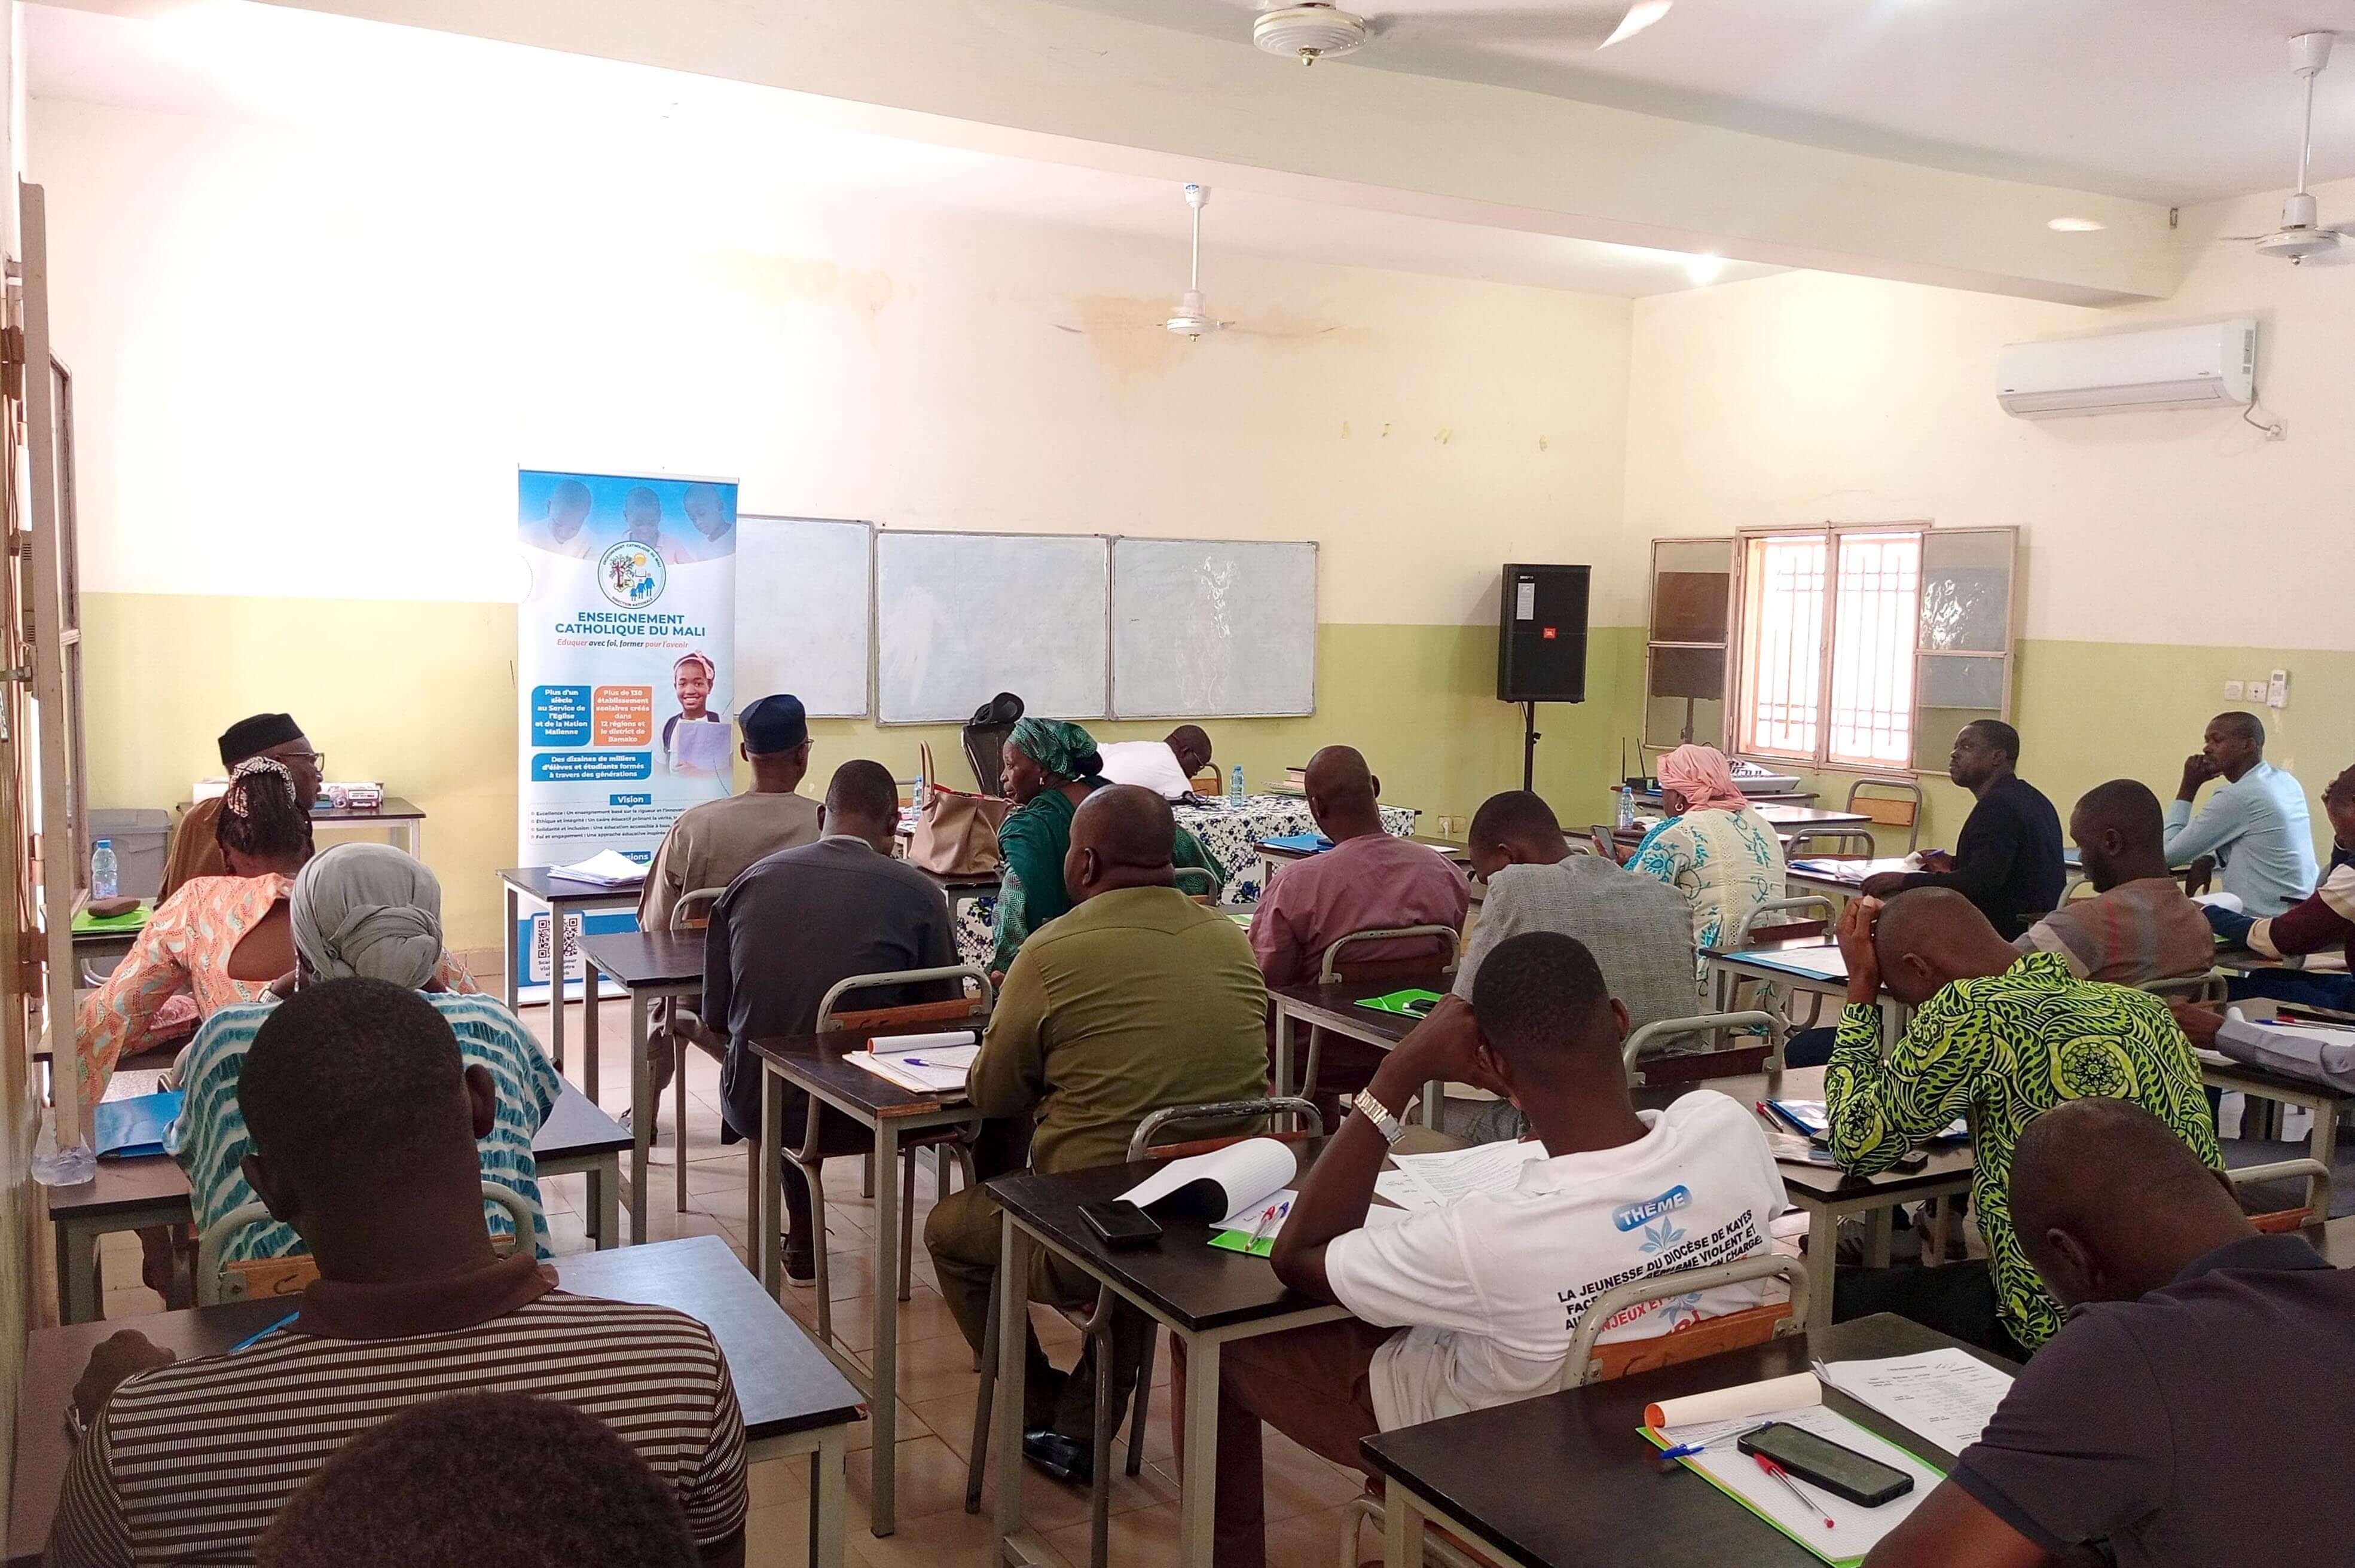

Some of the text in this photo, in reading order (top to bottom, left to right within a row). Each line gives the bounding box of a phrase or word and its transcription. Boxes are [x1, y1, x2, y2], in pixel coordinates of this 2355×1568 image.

[578, 612, 685, 624] ENSEIGNEMENT
[555, 623, 705, 637] CATHOLIQUE DU MALI
[606, 639, 618, 647] foi,
[617, 795, 644, 803] Vision
[1699, 1231, 1743, 1263] VIOLENT
[1746, 1223, 1756, 1238] ET
[1557, 1209, 1752, 1303] LA JEUNESSE DU DIOCÈSE DE KAYES
[1601, 1303, 1647, 1332] NJEUX
